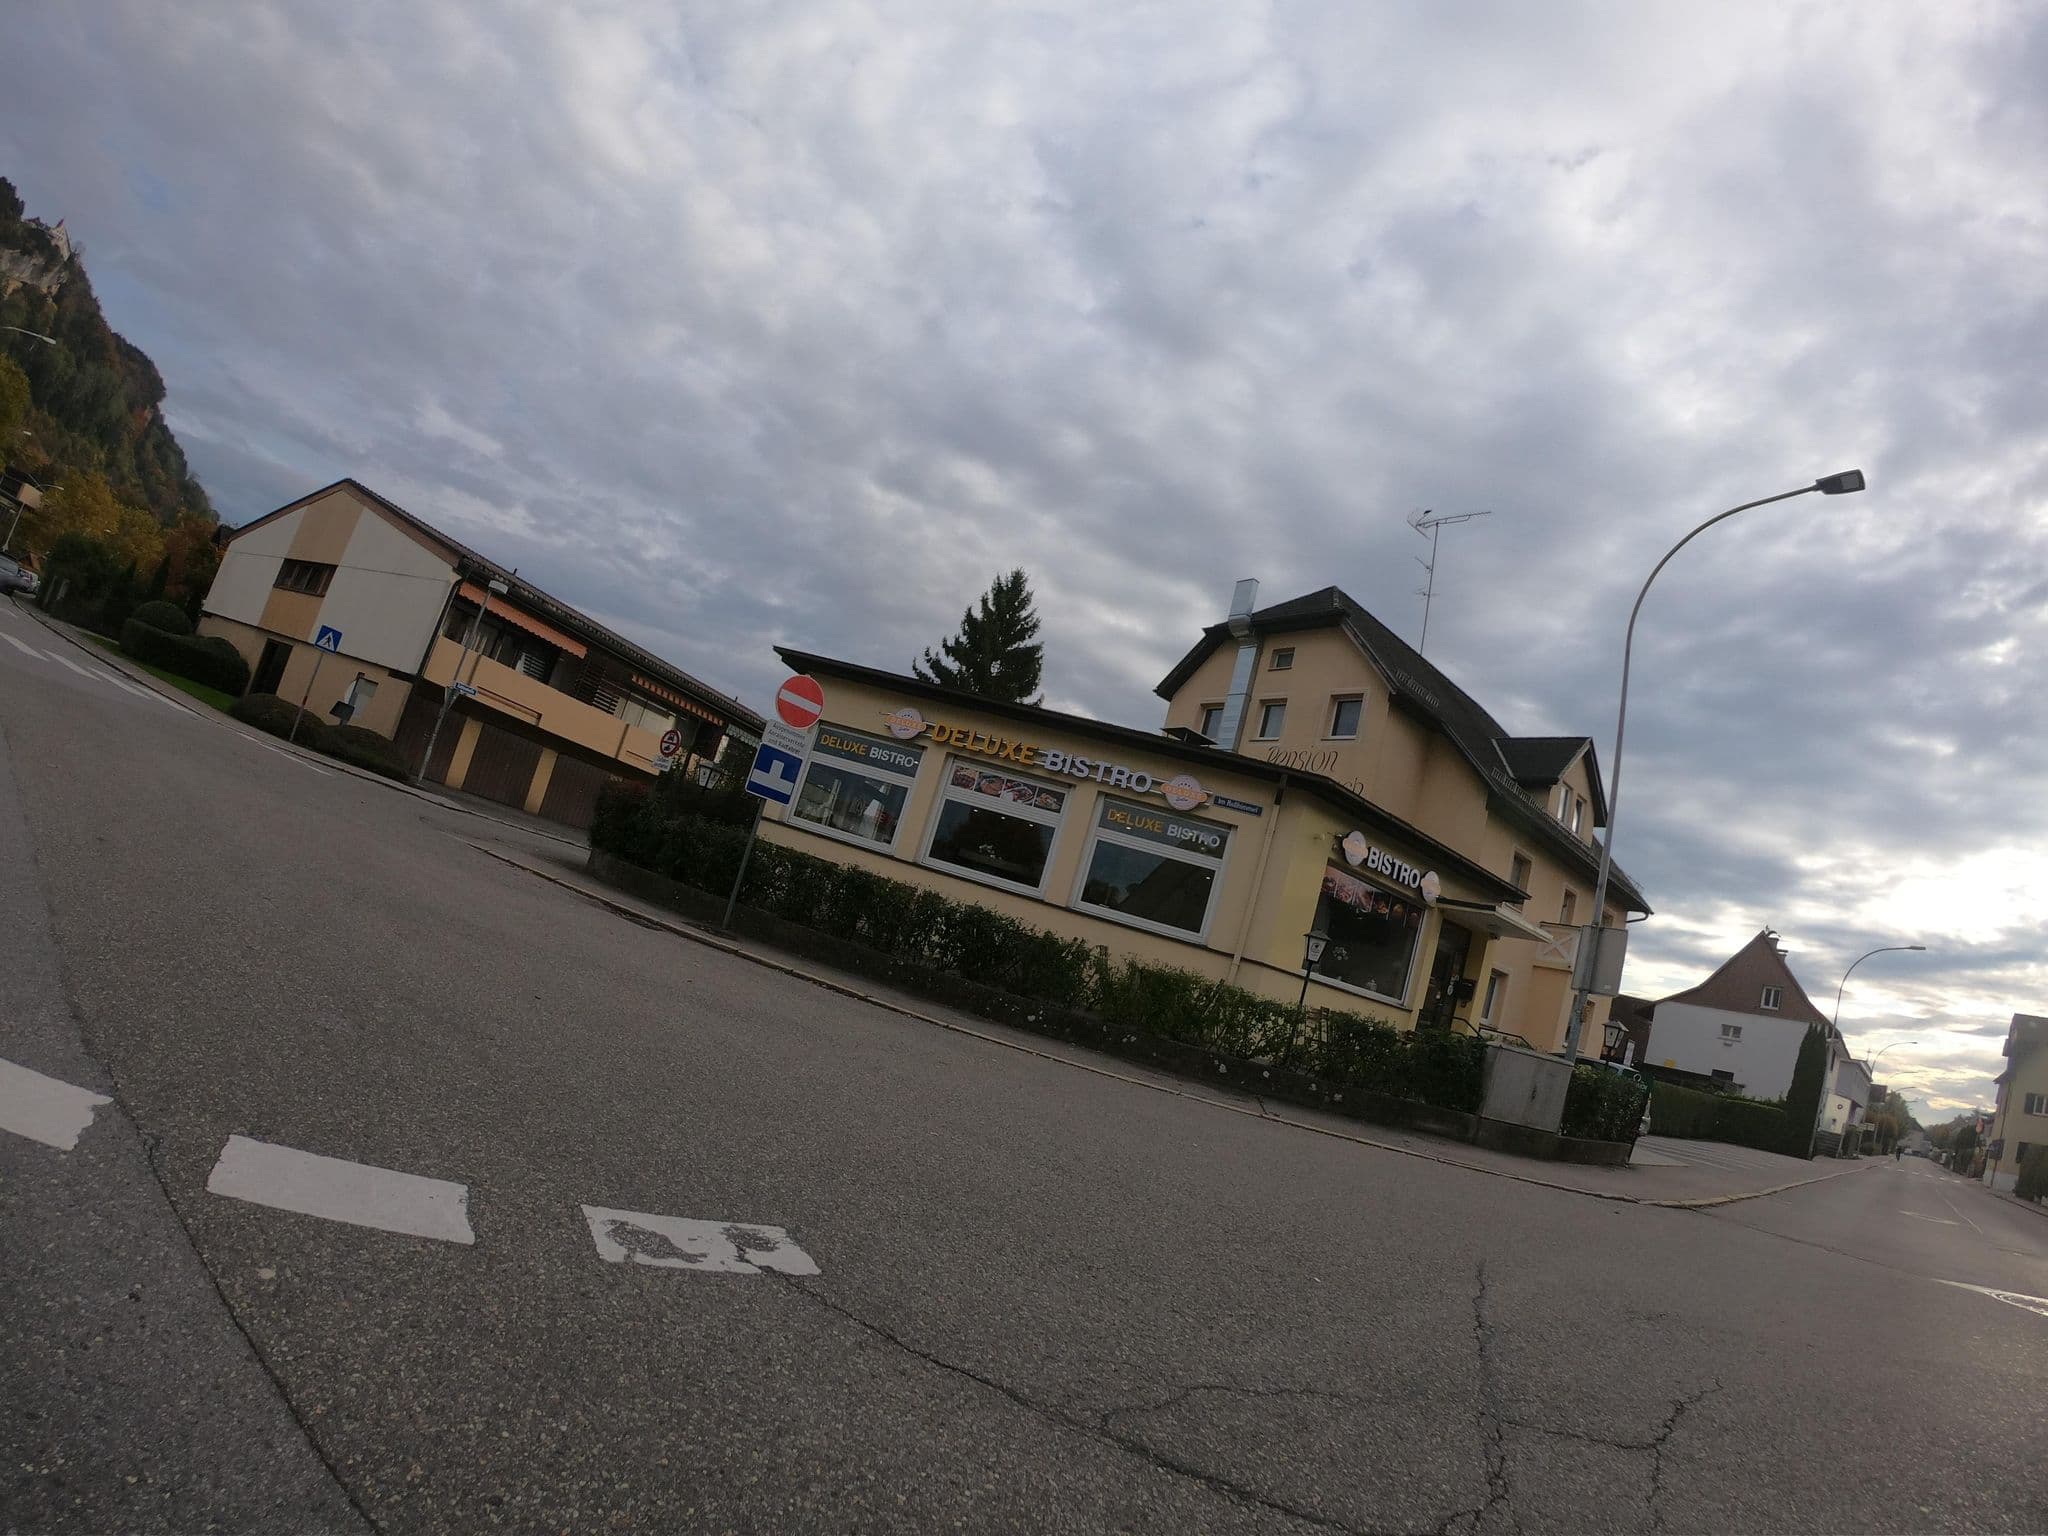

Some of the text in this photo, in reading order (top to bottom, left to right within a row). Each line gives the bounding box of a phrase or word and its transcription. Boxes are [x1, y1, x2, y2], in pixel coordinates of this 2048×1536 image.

[821, 734, 867, 756] DELUXE
[932, 722, 1153, 794] DELUXE BISTRO
[1107, 809, 1221, 848] DELUXE BISTRO
[1367, 847, 1420, 888] BISTRO
